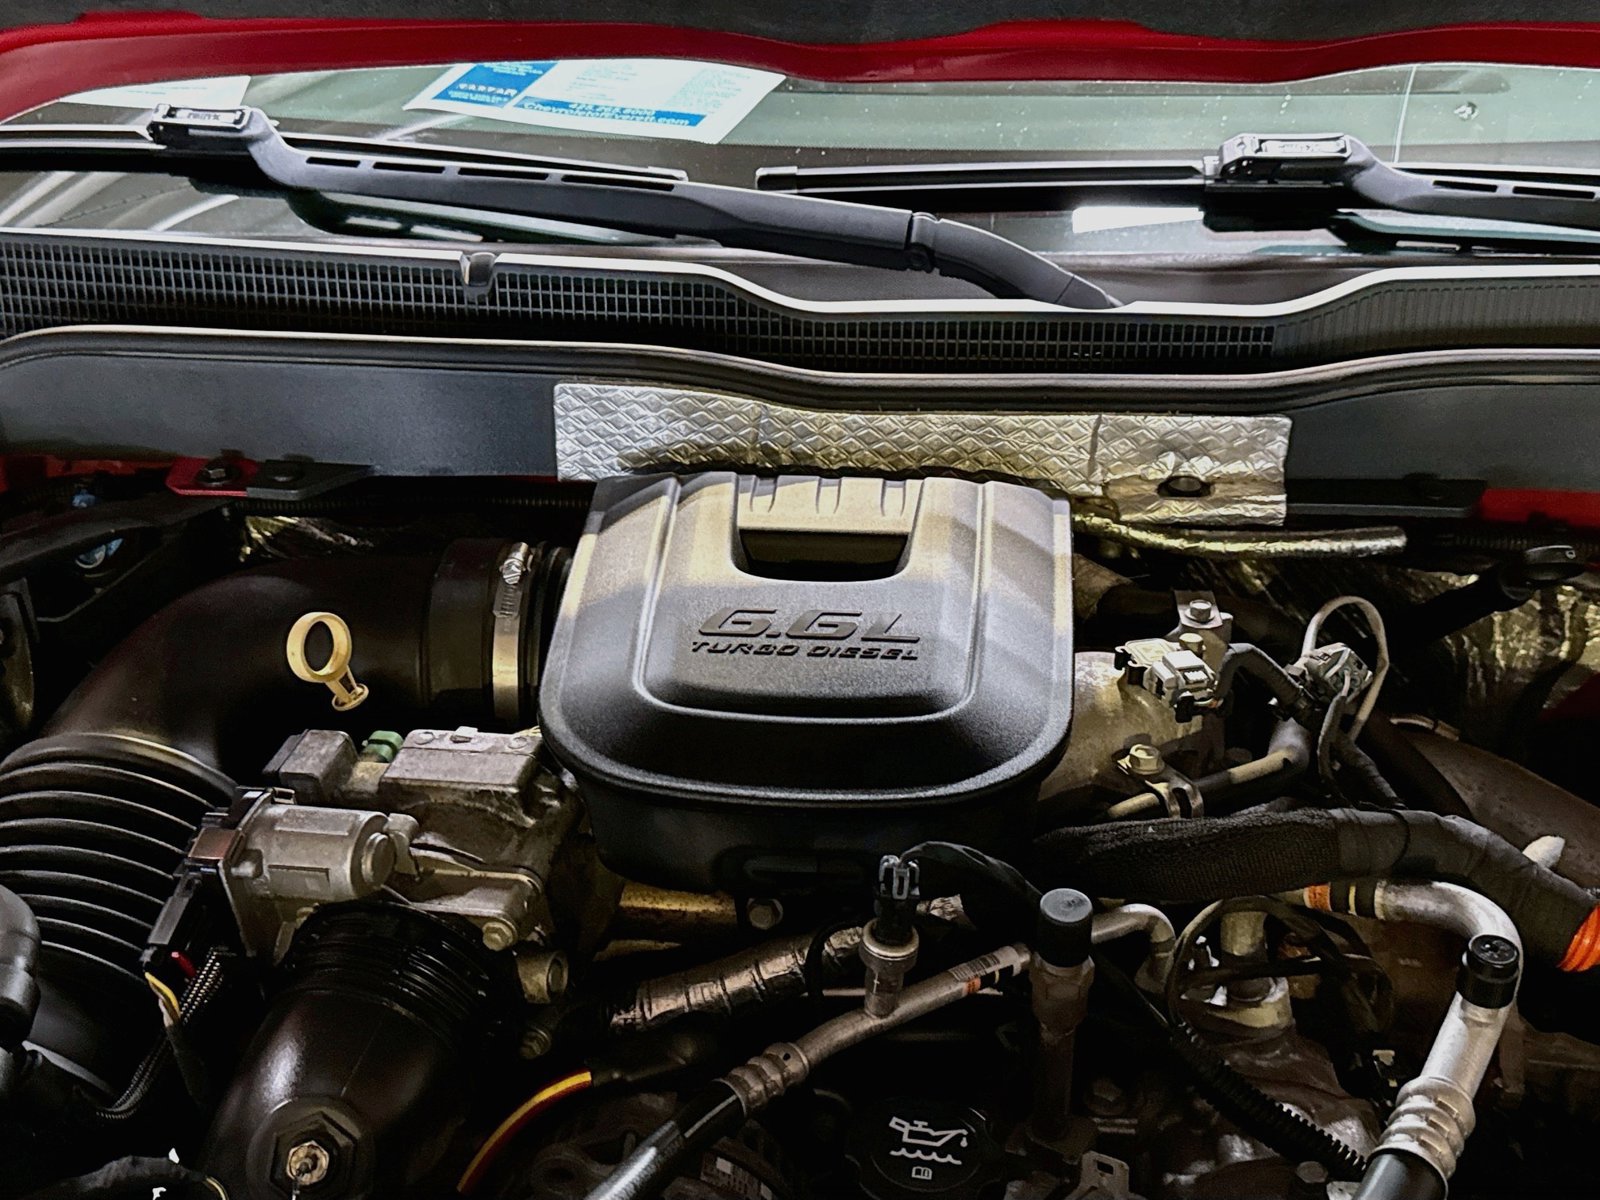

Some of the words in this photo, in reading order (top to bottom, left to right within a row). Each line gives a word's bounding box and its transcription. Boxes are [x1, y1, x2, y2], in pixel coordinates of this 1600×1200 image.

[698, 608, 920, 643] 6.6L
[691, 641, 800, 656] TURBO
[806, 645, 920, 661] DIESEL
